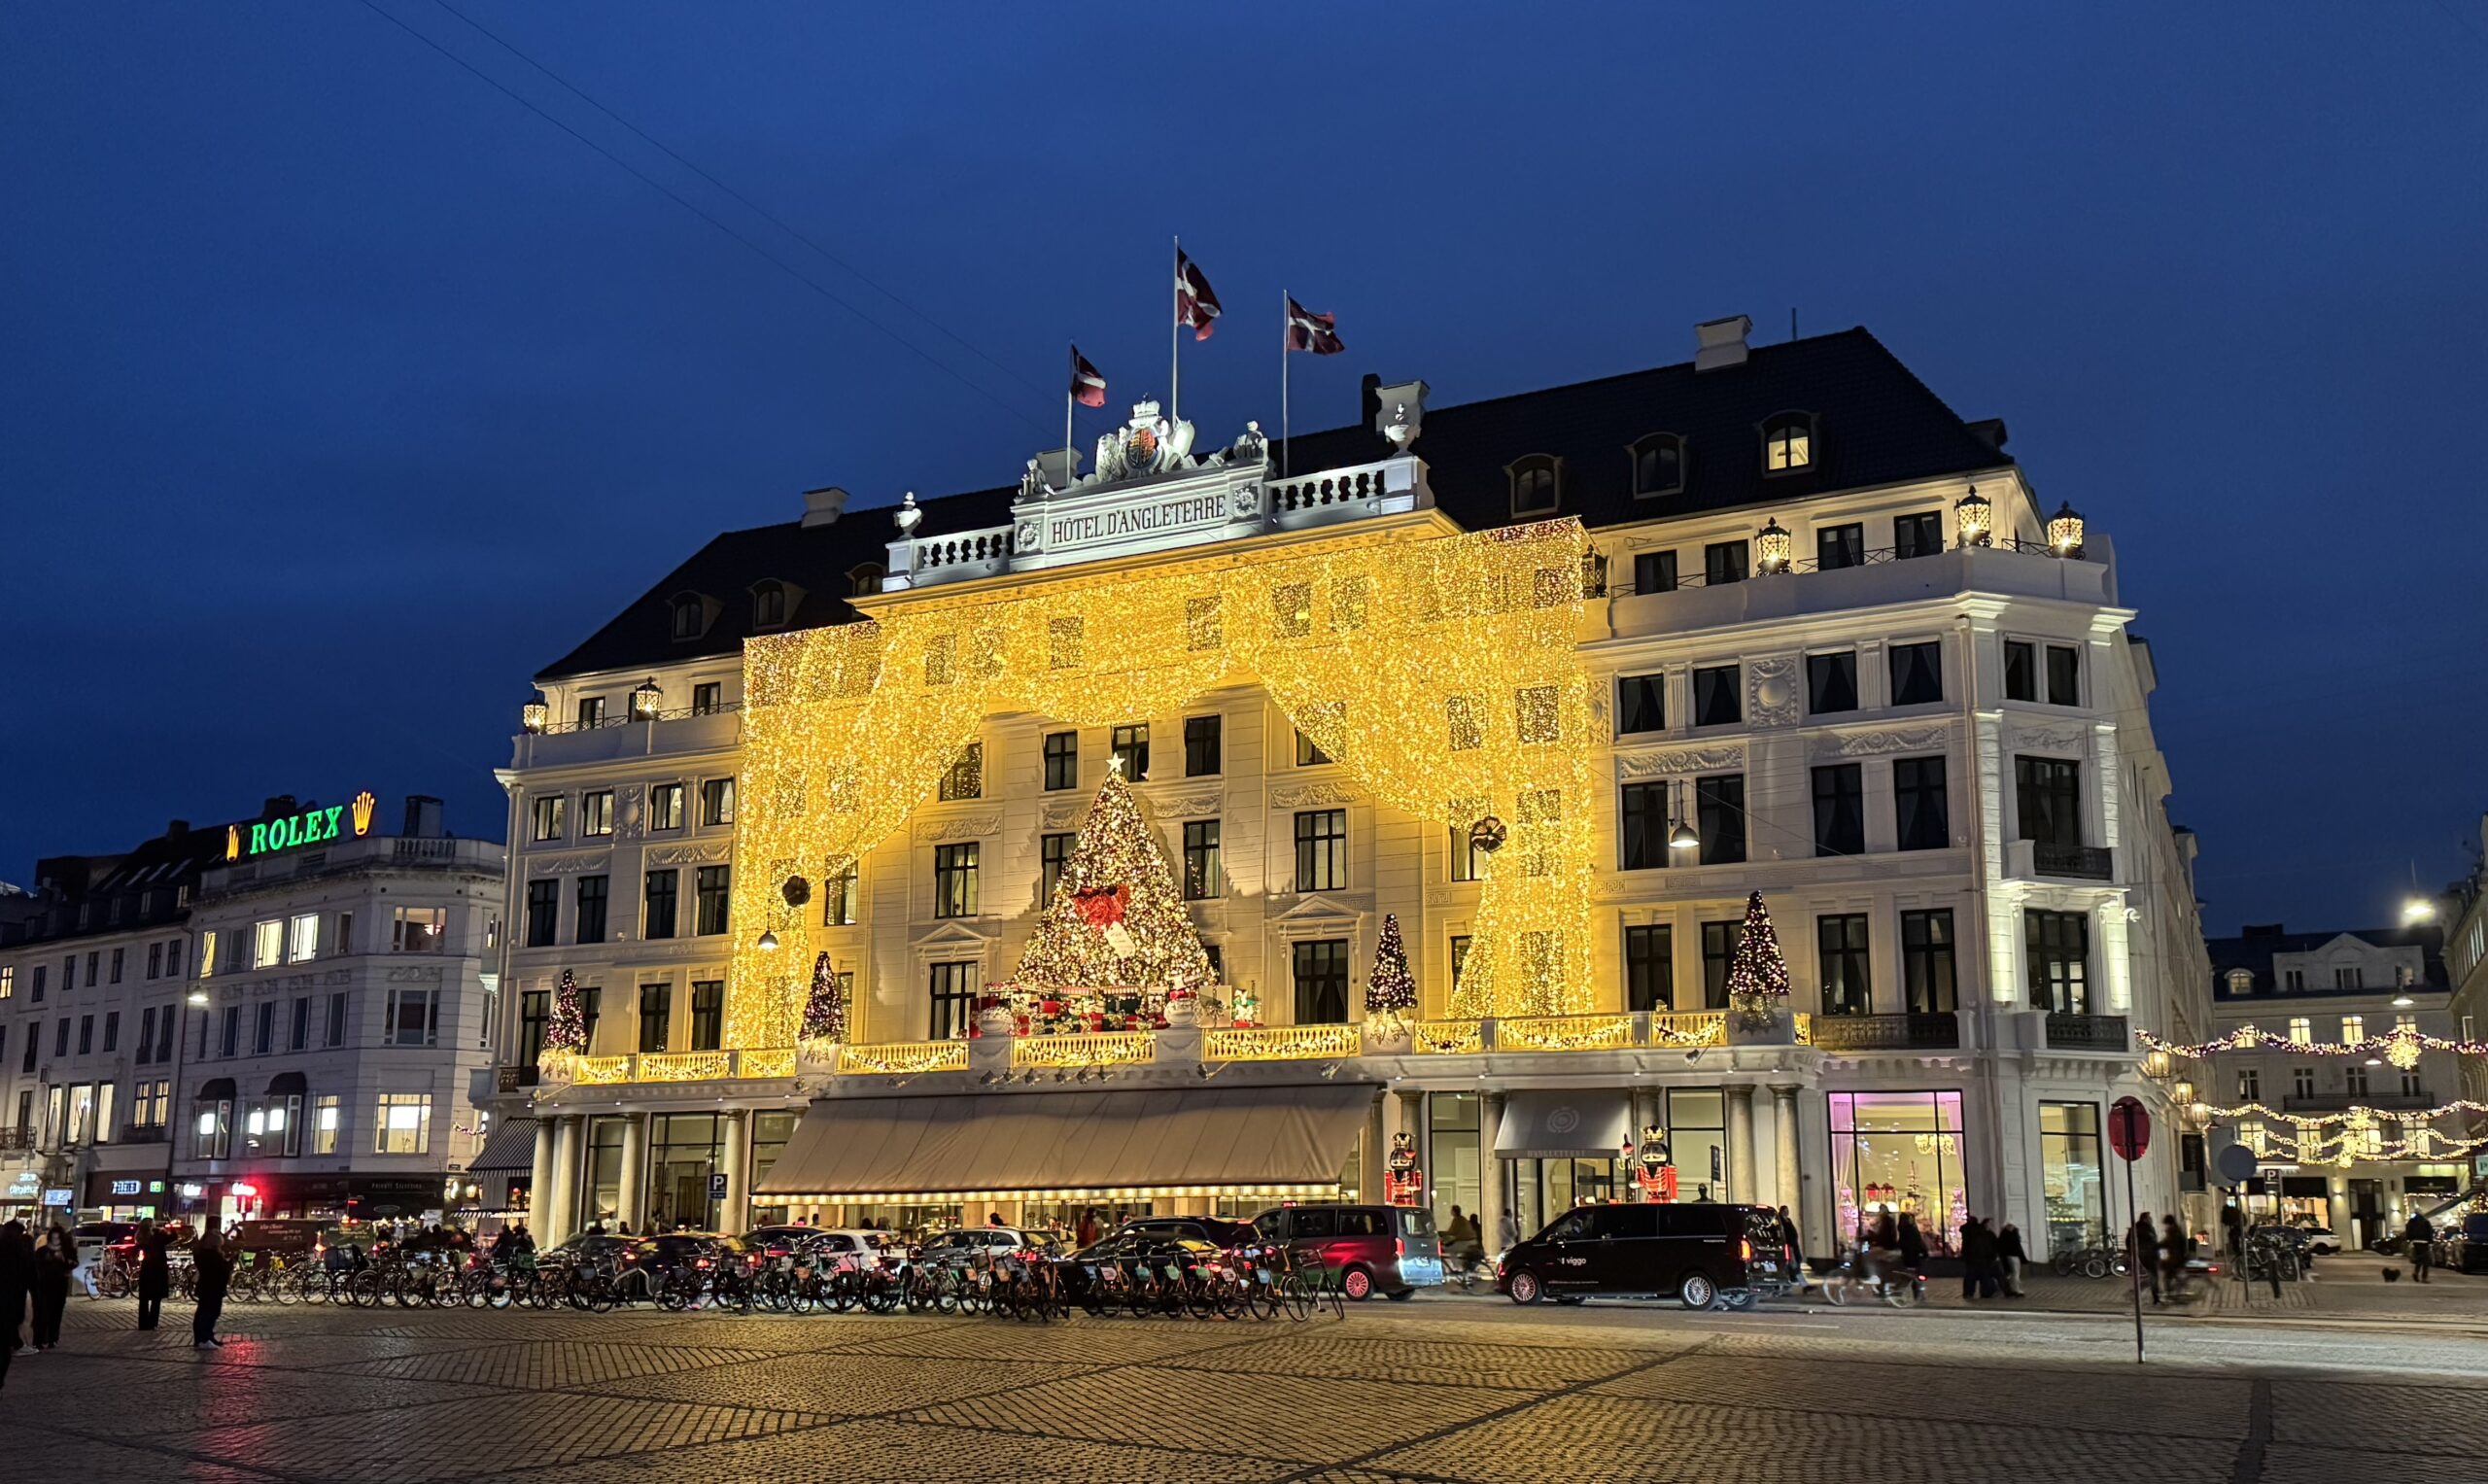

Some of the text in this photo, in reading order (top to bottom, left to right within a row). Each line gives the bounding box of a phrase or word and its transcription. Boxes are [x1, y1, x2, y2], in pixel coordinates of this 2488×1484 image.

[1052, 495, 1227, 544] HÔTEL D'ANGLETERRE
[249, 805, 343, 855] ROLEX
[712, 1175, 725, 1191] P
[2266, 1169, 2276, 1181] P
[1566, 1257, 1587, 1266] viggo
